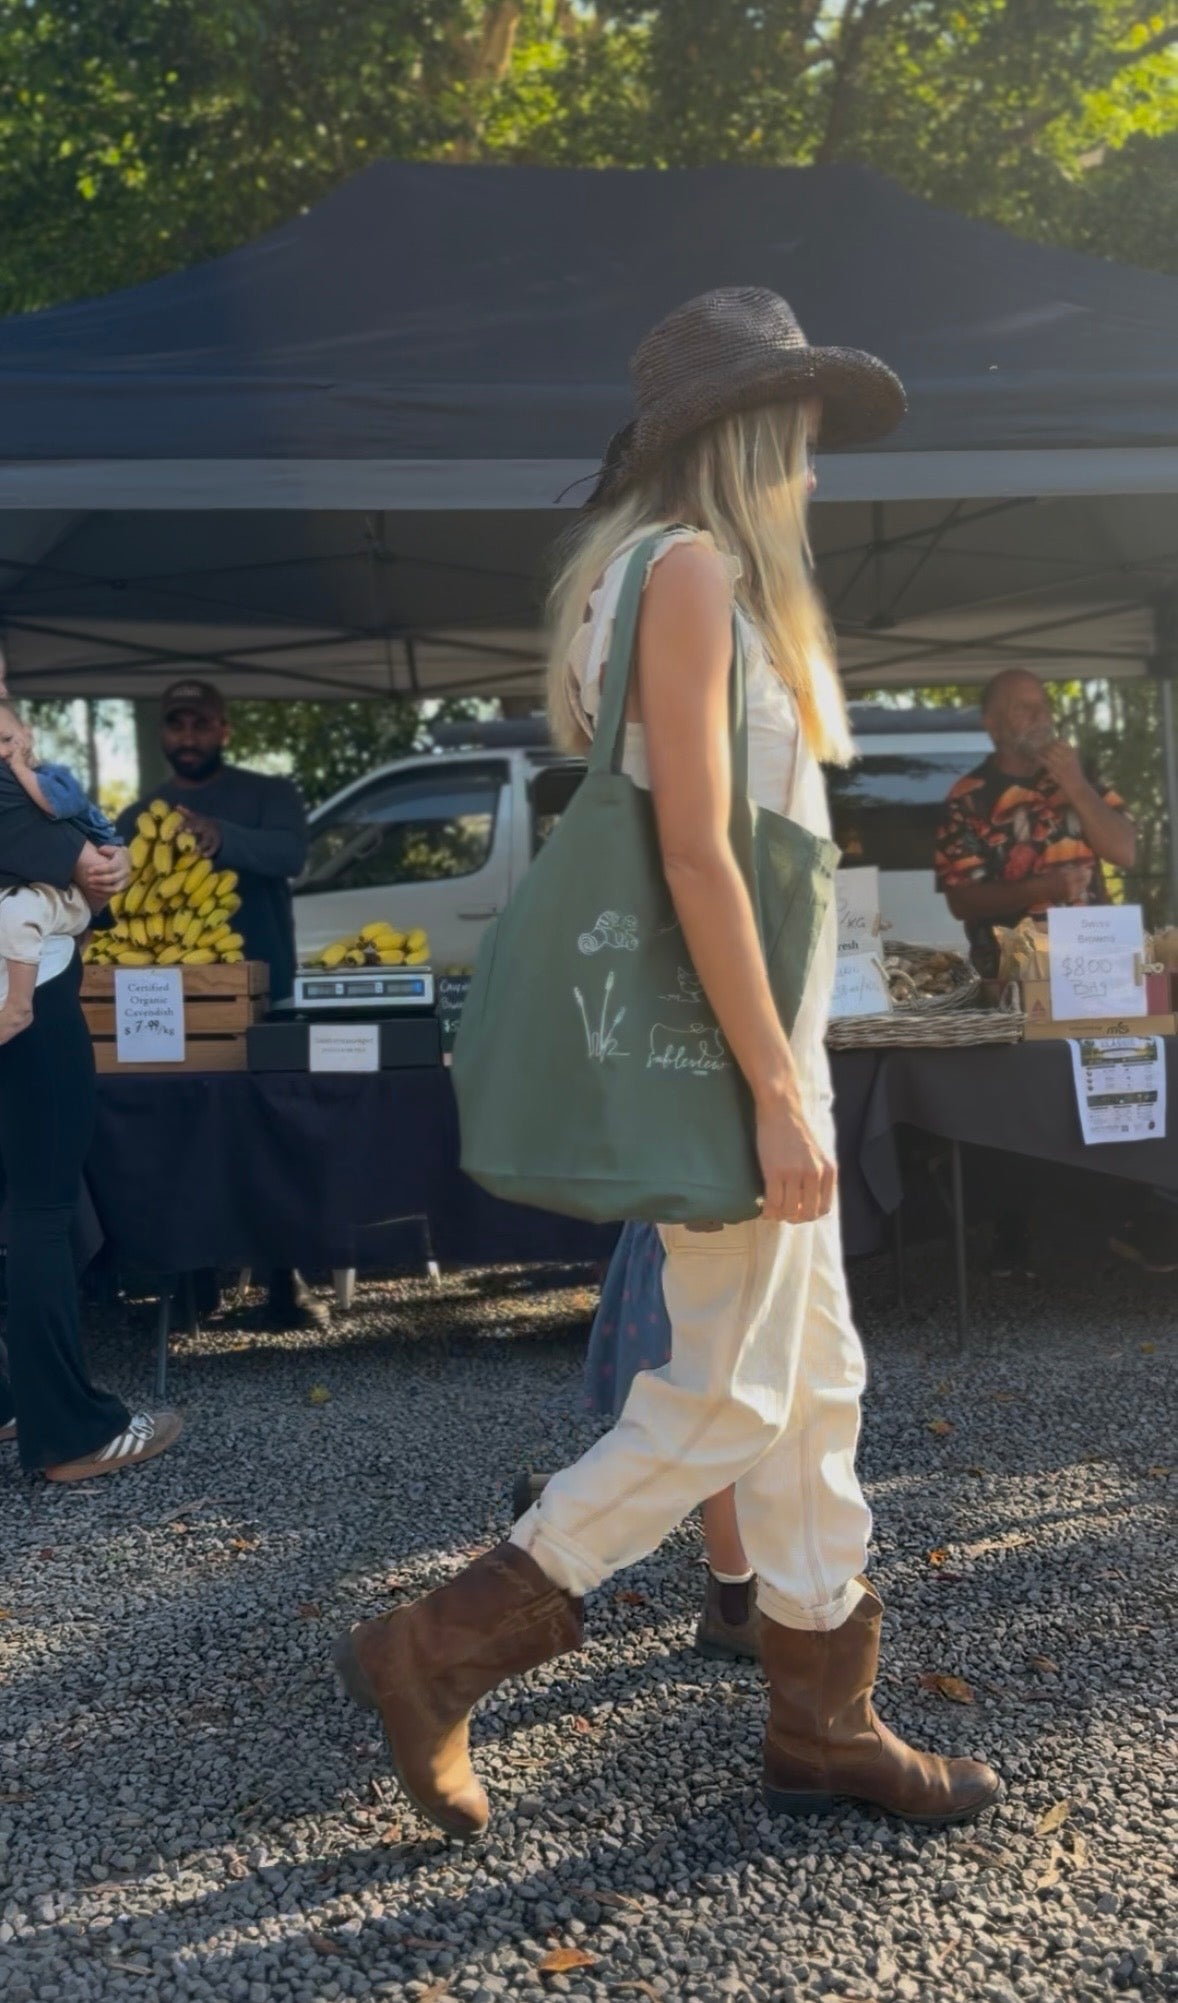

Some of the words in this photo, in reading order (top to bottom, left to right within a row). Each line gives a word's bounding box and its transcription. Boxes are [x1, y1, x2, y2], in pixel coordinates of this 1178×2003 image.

[837, 939, 859, 951] resh
[129, 996, 168, 1007] Organic
[124, 1007, 174, 1018] Cavendish
